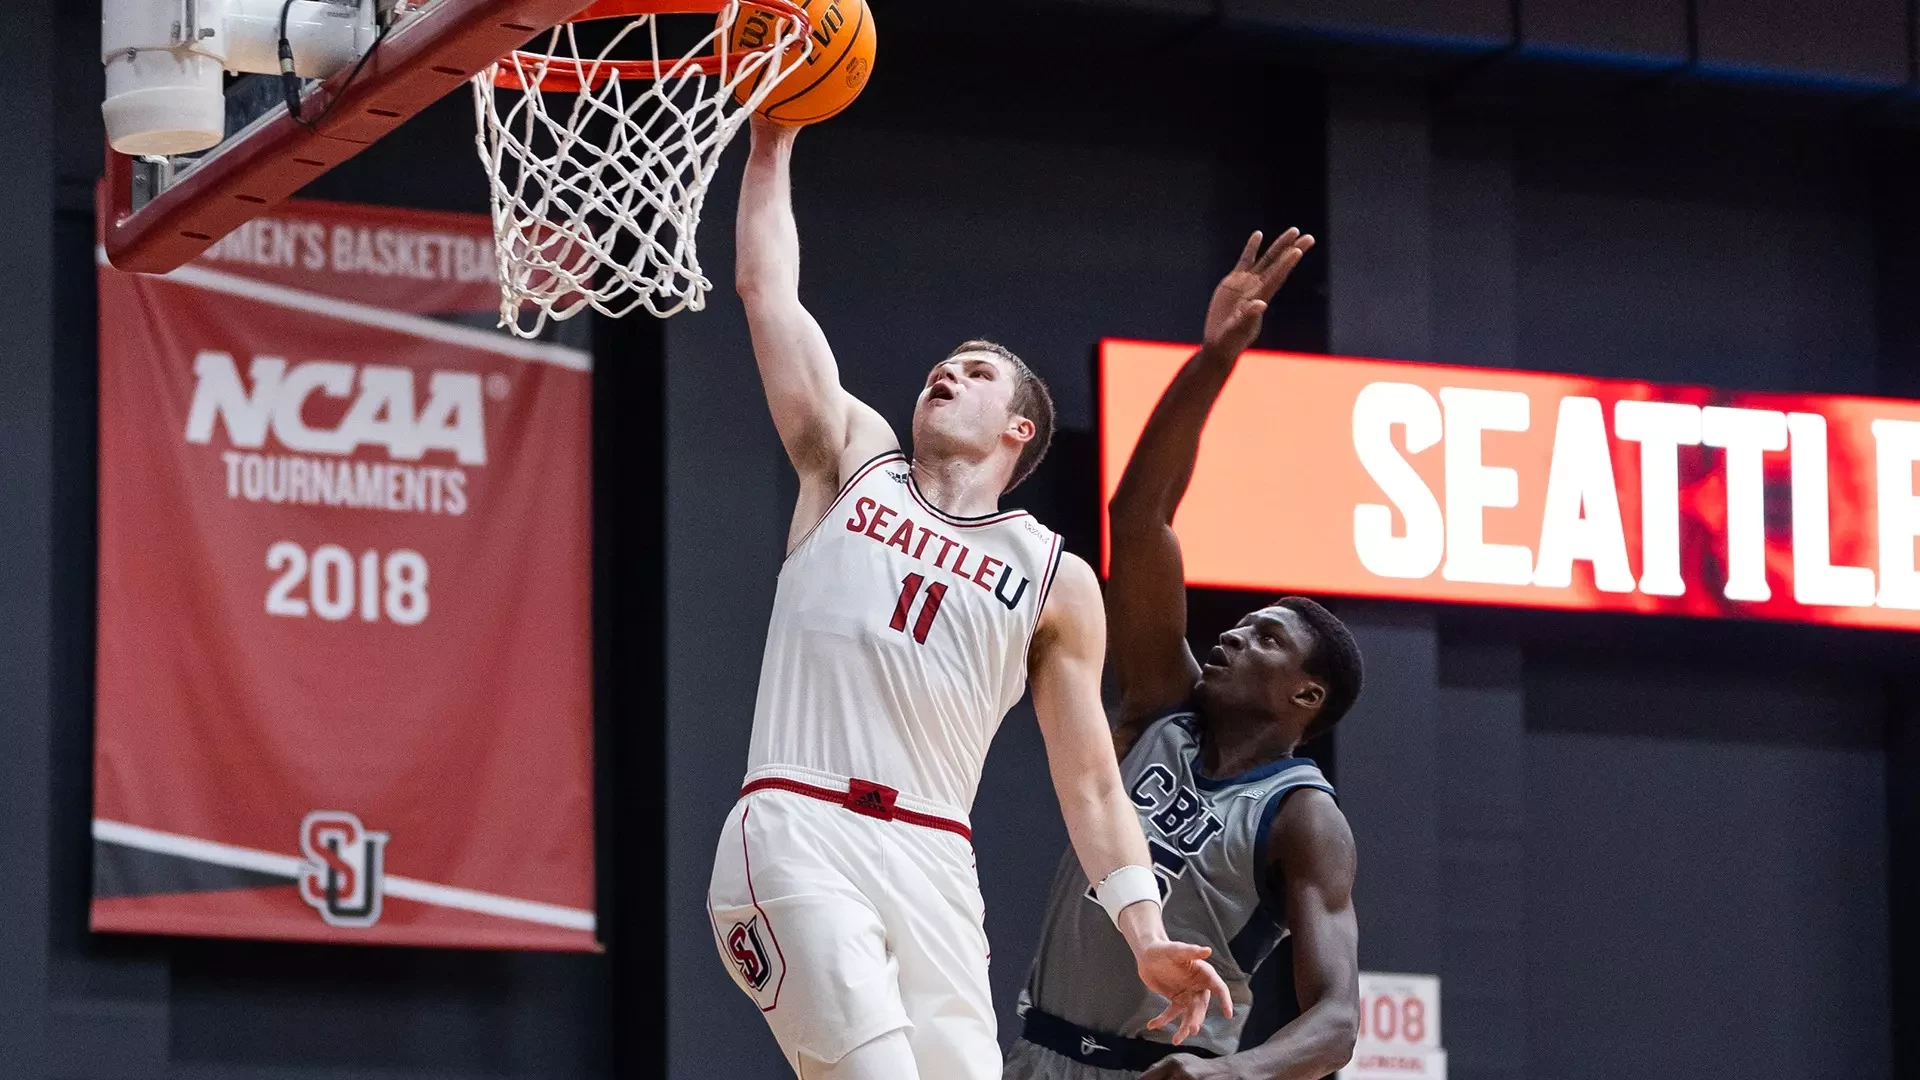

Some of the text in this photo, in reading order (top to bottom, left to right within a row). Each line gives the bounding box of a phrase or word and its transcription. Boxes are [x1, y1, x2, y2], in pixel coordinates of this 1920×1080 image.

[201, 217, 502, 283] MEN'S BASKETBA
[185, 350, 487, 467] NCAA
[223, 451, 468, 516] TOURNAMENTS
[1352, 381, 1920, 610] SEATTLE
[264, 541, 430, 625] 2018
[889, 572, 949, 646] 11
[1130, 763, 1225, 856] CBU
